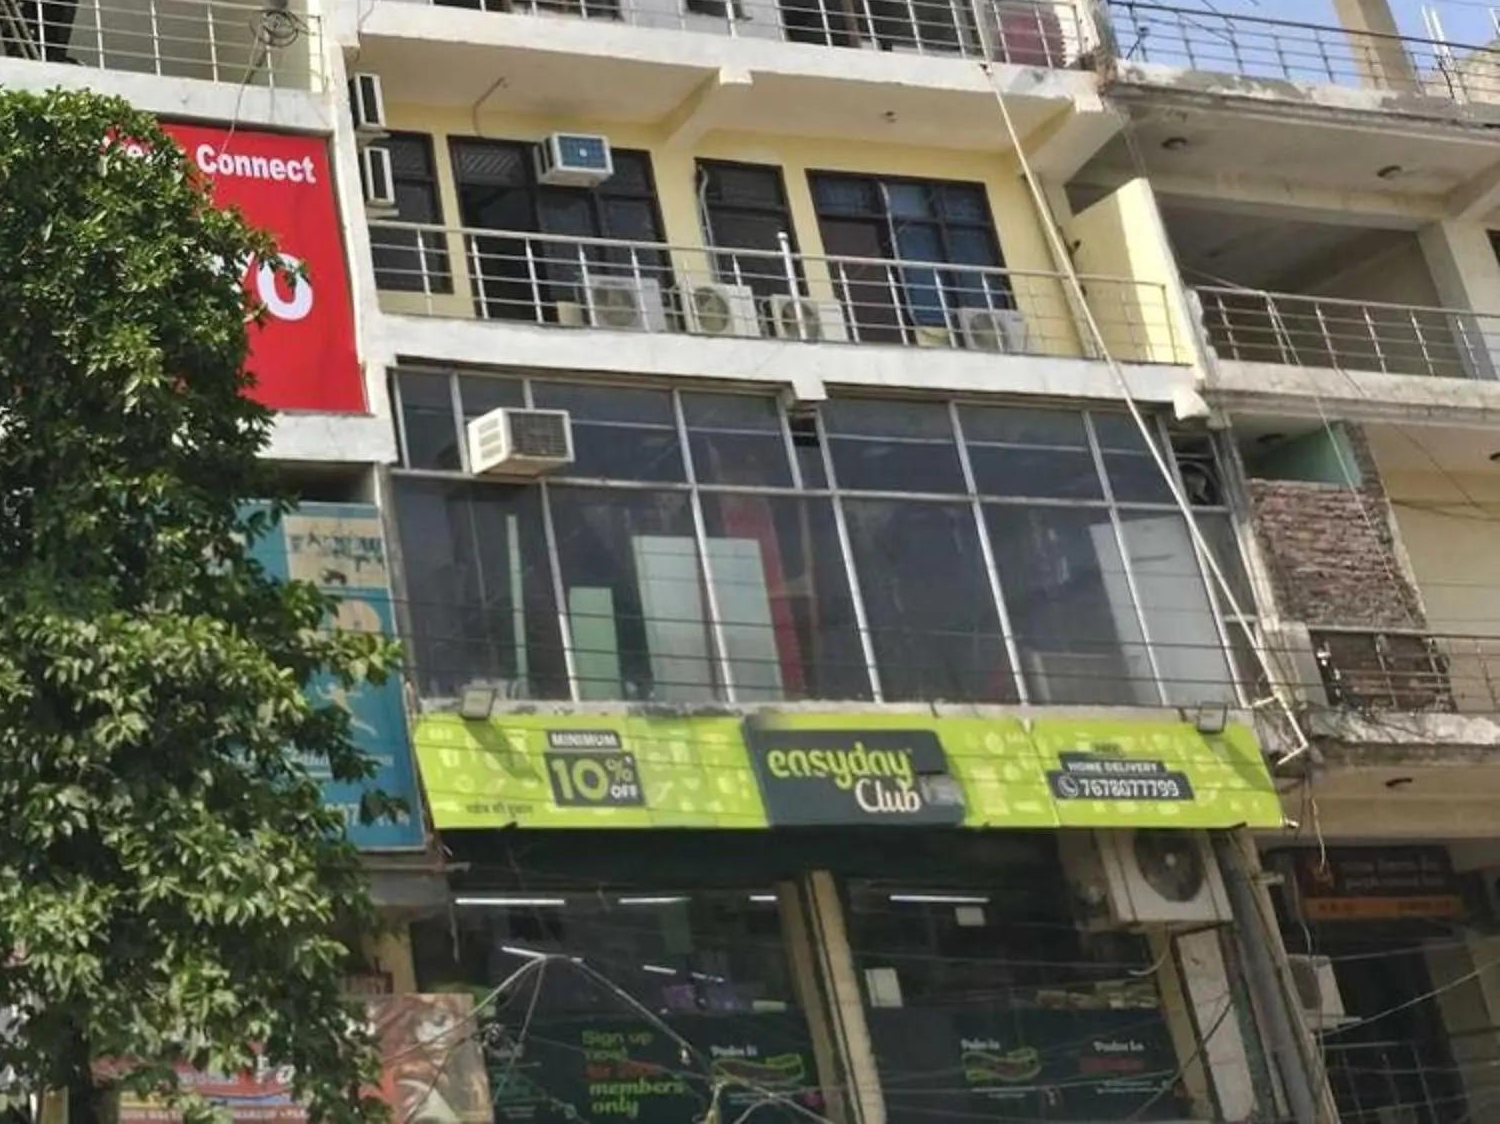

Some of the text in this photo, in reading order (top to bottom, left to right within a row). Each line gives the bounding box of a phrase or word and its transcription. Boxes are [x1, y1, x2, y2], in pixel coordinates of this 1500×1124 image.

[195, 142, 317, 183] Connect
[550, 732, 619, 747] MINIMUM
[766, 741, 913, 790] easyday
[1067, 762, 1157, 773] HOME DELIVERY
[610, 783, 639, 799] OFF
[854, 777, 921, 812] Club
[1079, 778, 1179, 797] 7678077799
